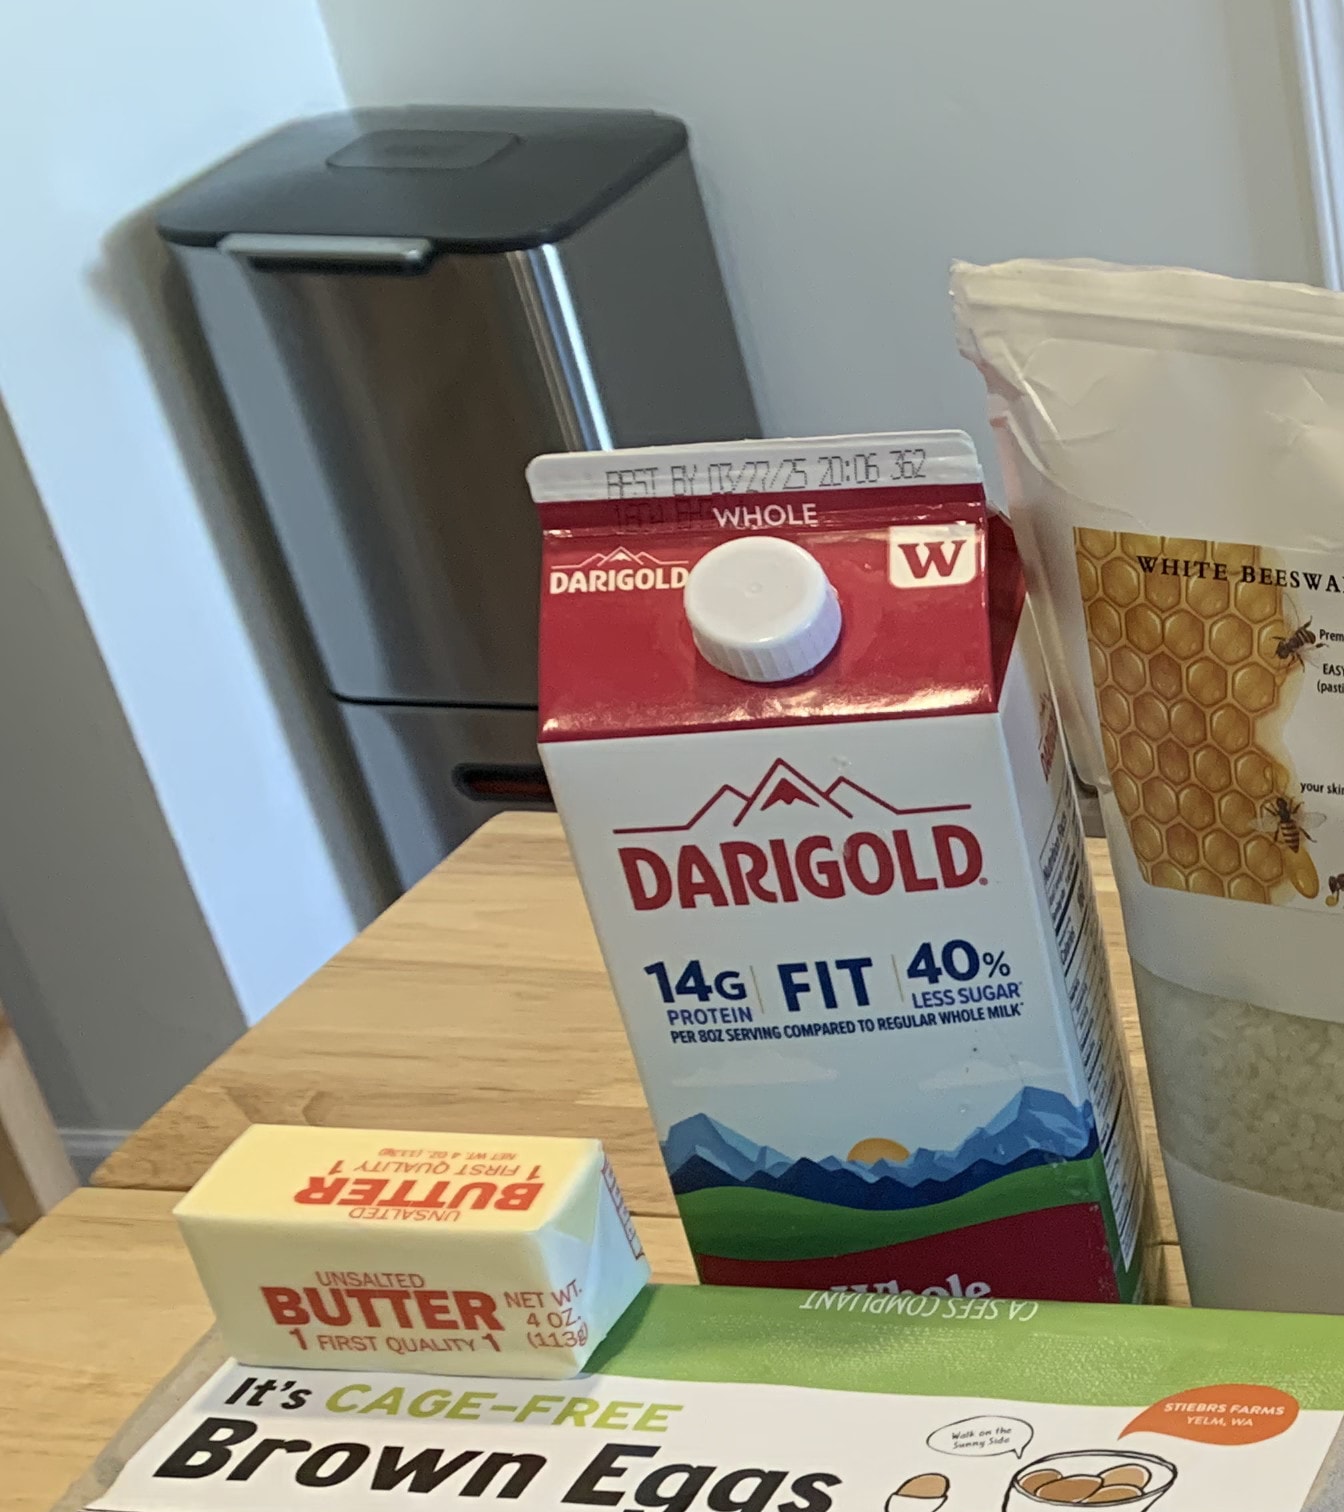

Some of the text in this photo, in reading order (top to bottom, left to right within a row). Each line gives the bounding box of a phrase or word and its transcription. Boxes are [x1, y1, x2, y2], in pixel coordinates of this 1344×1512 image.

[671, 464, 698, 497] BY
[817, 453, 881, 487] 20:06
[713, 503, 819, 529] WHOLE
[896, 539, 968, 580] W
[1134, 555, 1227, 581] WHITE
[550, 566, 691, 595] DARIGOLD
[618, 824, 984, 912] DARIGOLD
[906, 939, 1011, 984] 40%
[643, 959, 748, 1003] 14G
[777, 956, 875, 1012] FIT
[911, 988, 957, 1010] LESS
[667, 1006, 754, 1027] PROTEIN
[669, 1028, 697, 1045] PER
[726, 1025, 783, 1043] SERVING
[784, 1019, 857, 1040] COMPARED
[859, 1018, 876, 1033] TO
[877, 1012, 938, 1032] REGULAR
[939, 1007, 986, 1026] WHOLE
[327, 1159, 543, 1182] 1 FIRST QUALITY 1
[293, 1176, 546, 1212] BUTTER
[348, 1206, 462, 1223] UNSALTED
[314, 1270, 426, 1290] UNSALTED
[503, 1278, 584, 1310] NET WT.
[260, 1285, 506, 1332] BUTTER
[527, 1306, 582, 1329] 4 OZ.
[799, 1290, 1039, 1322] CA SEFS COMPLIANT
[289, 1327, 503, 1356] 1 FIRST QUALITY 1
[225, 1376, 685, 1433] It's CAGE-FREE
[1163, 1401, 1286, 1416] STIEBRS FARMS
[951, 1429, 975, 1440] Walk
[995, 1426, 1012, 1435] the
[1185, 1414, 1254, 1427] YELM, WA
[952, 1436, 1011, 1450] Sunny Side
[153, 1417, 548, 1500] Brown
